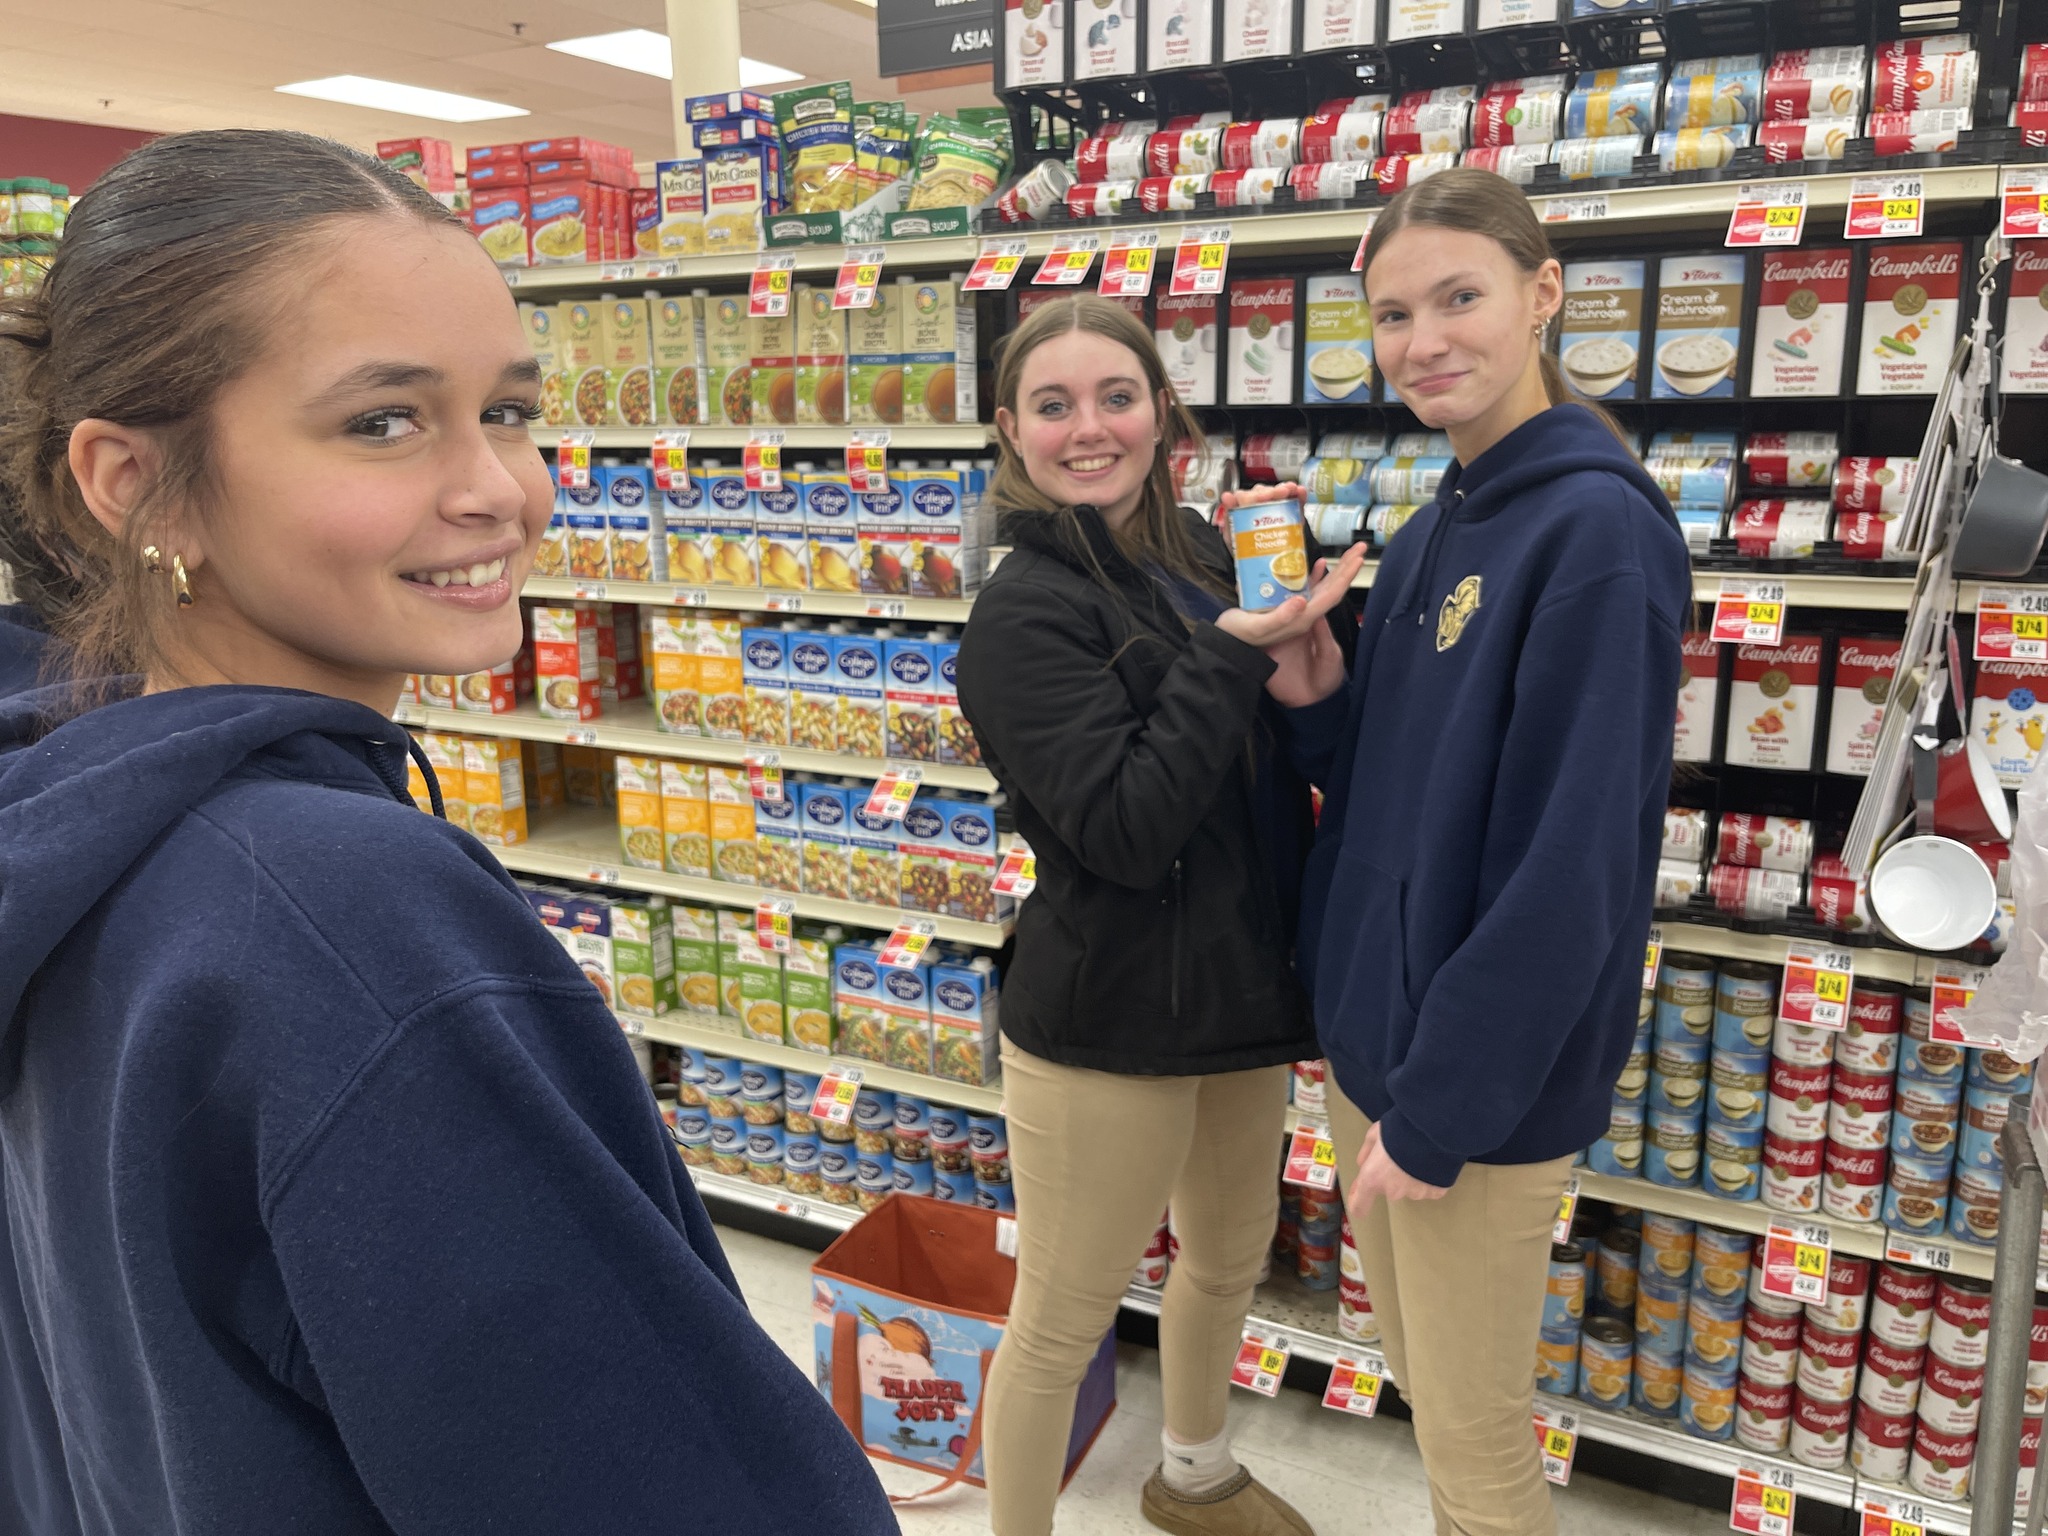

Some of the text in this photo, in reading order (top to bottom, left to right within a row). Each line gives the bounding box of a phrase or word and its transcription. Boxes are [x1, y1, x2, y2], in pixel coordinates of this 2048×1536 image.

[1892, 182, 1921, 198] $2.49
[808, 225, 833, 235] SOUP
[932, 221, 960, 232] SOUP
[1763, 258, 1850, 284] Campbell's
[1869, 253, 1959, 279] Campbell's
[1230, 288, 1292, 308] Campbell's
[1566, 297, 1621, 310] Cream of
[1660, 291, 1720, 306] Cream of
[1565, 308, 1627, 320] Mushroom
[1660, 304, 1726, 316] Mushroom
[1309, 318, 1340, 330] Celery
[1880, 362, 1928, 373] Vegetarian
[1881, 371, 1925, 382] Vegetable
[713, 487, 747, 501] College
[812, 492, 846, 506] College
[914, 490, 954, 505] College
[925, 504, 943, 515] Inn
[1253, 530, 1289, 541] Chicken
[1254, 539, 1288, 550] Noodle
[1751, 605, 1775, 619] 3/$4
[2016, 619, 2042, 634] 3/$4
[748, 646, 782, 662] College
[793, 650, 829, 666] College
[1737, 643, 1818, 666] Campbell's
[838, 654, 876, 672] College
[891, 659, 930, 676] College
[850, 666, 867, 677] Inn
[903, 671, 920, 682] Inn
[809, 803, 842, 819] College
[905, 815, 941, 830] College
[953, 821, 987, 836] College
[1826, 953, 1851, 970] $2.49
[842, 966, 875, 982] College
[888, 976, 923, 992] College
[1819, 978, 1842, 996] 3/$4
[939, 986, 975, 1002] College
[880, 1376, 967, 1402] TRADER
